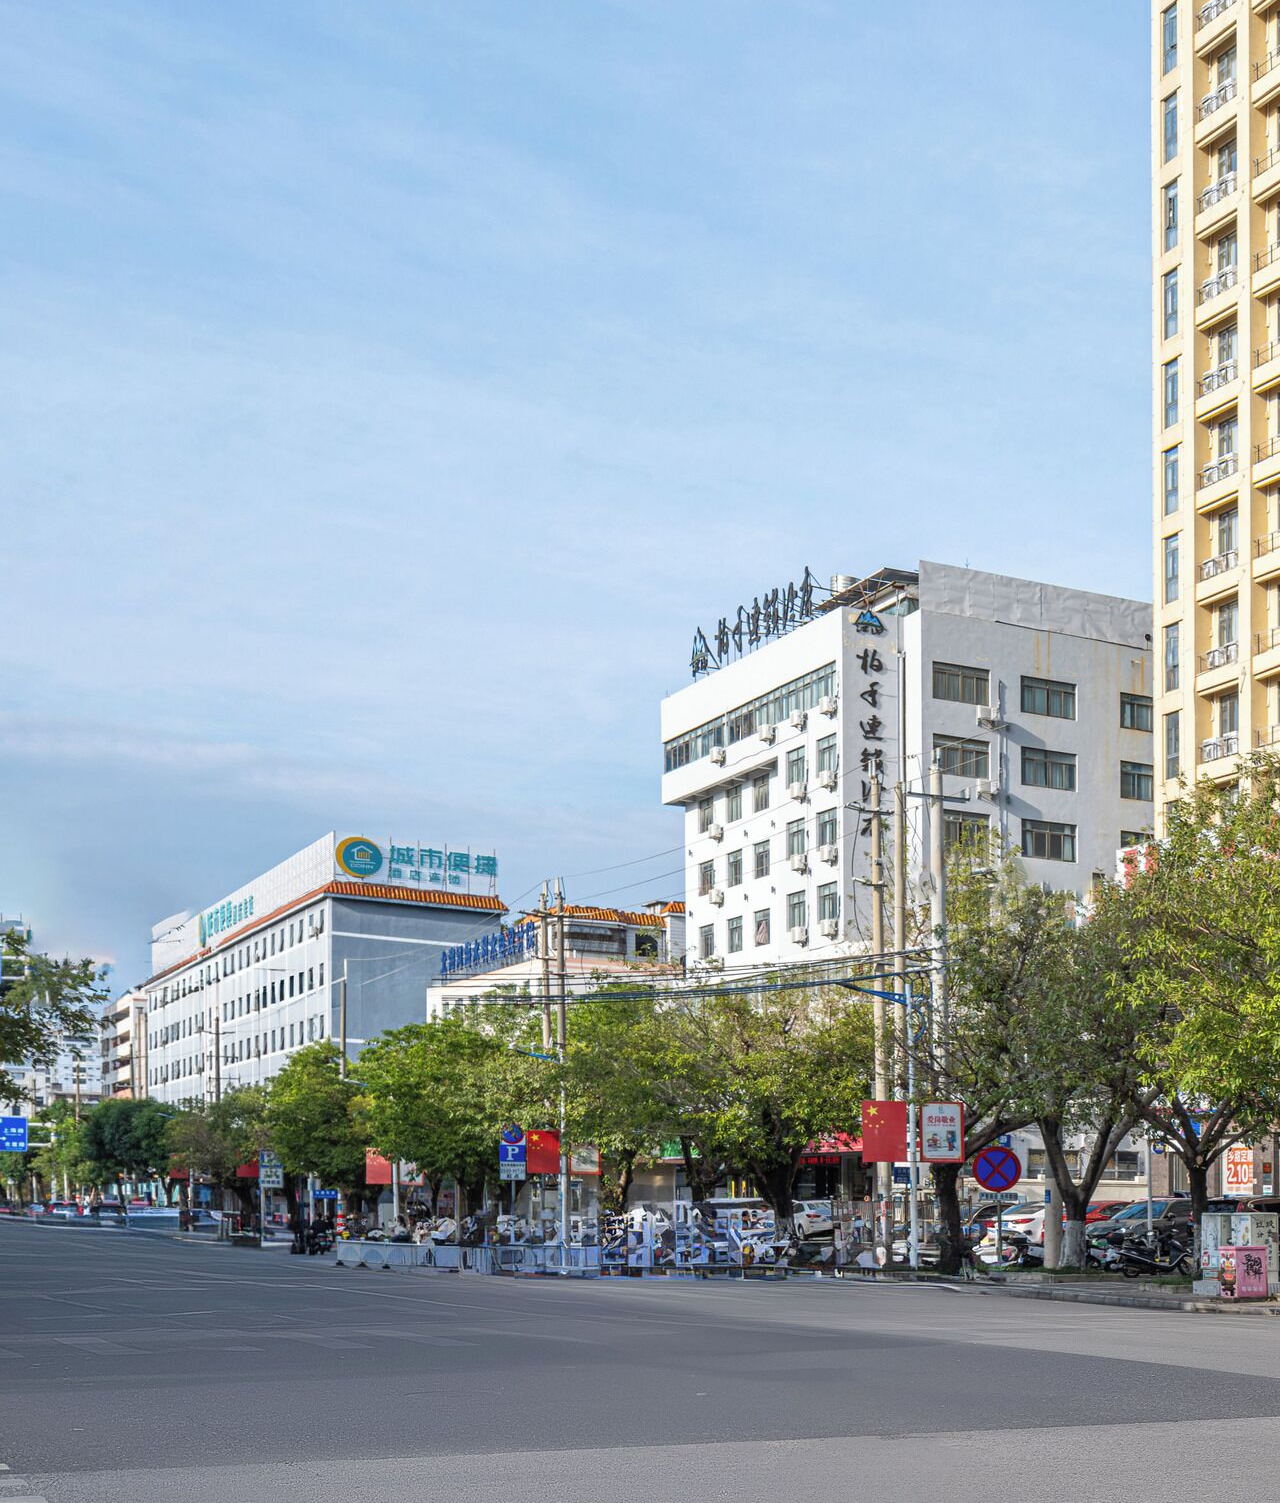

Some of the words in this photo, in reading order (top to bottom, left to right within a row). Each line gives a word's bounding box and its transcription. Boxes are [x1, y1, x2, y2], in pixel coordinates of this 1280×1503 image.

[389, 845, 498, 877] 城市便捷
[506, 1146, 519, 1160] P
[1227, 1163, 1249, 1183] 2.10
